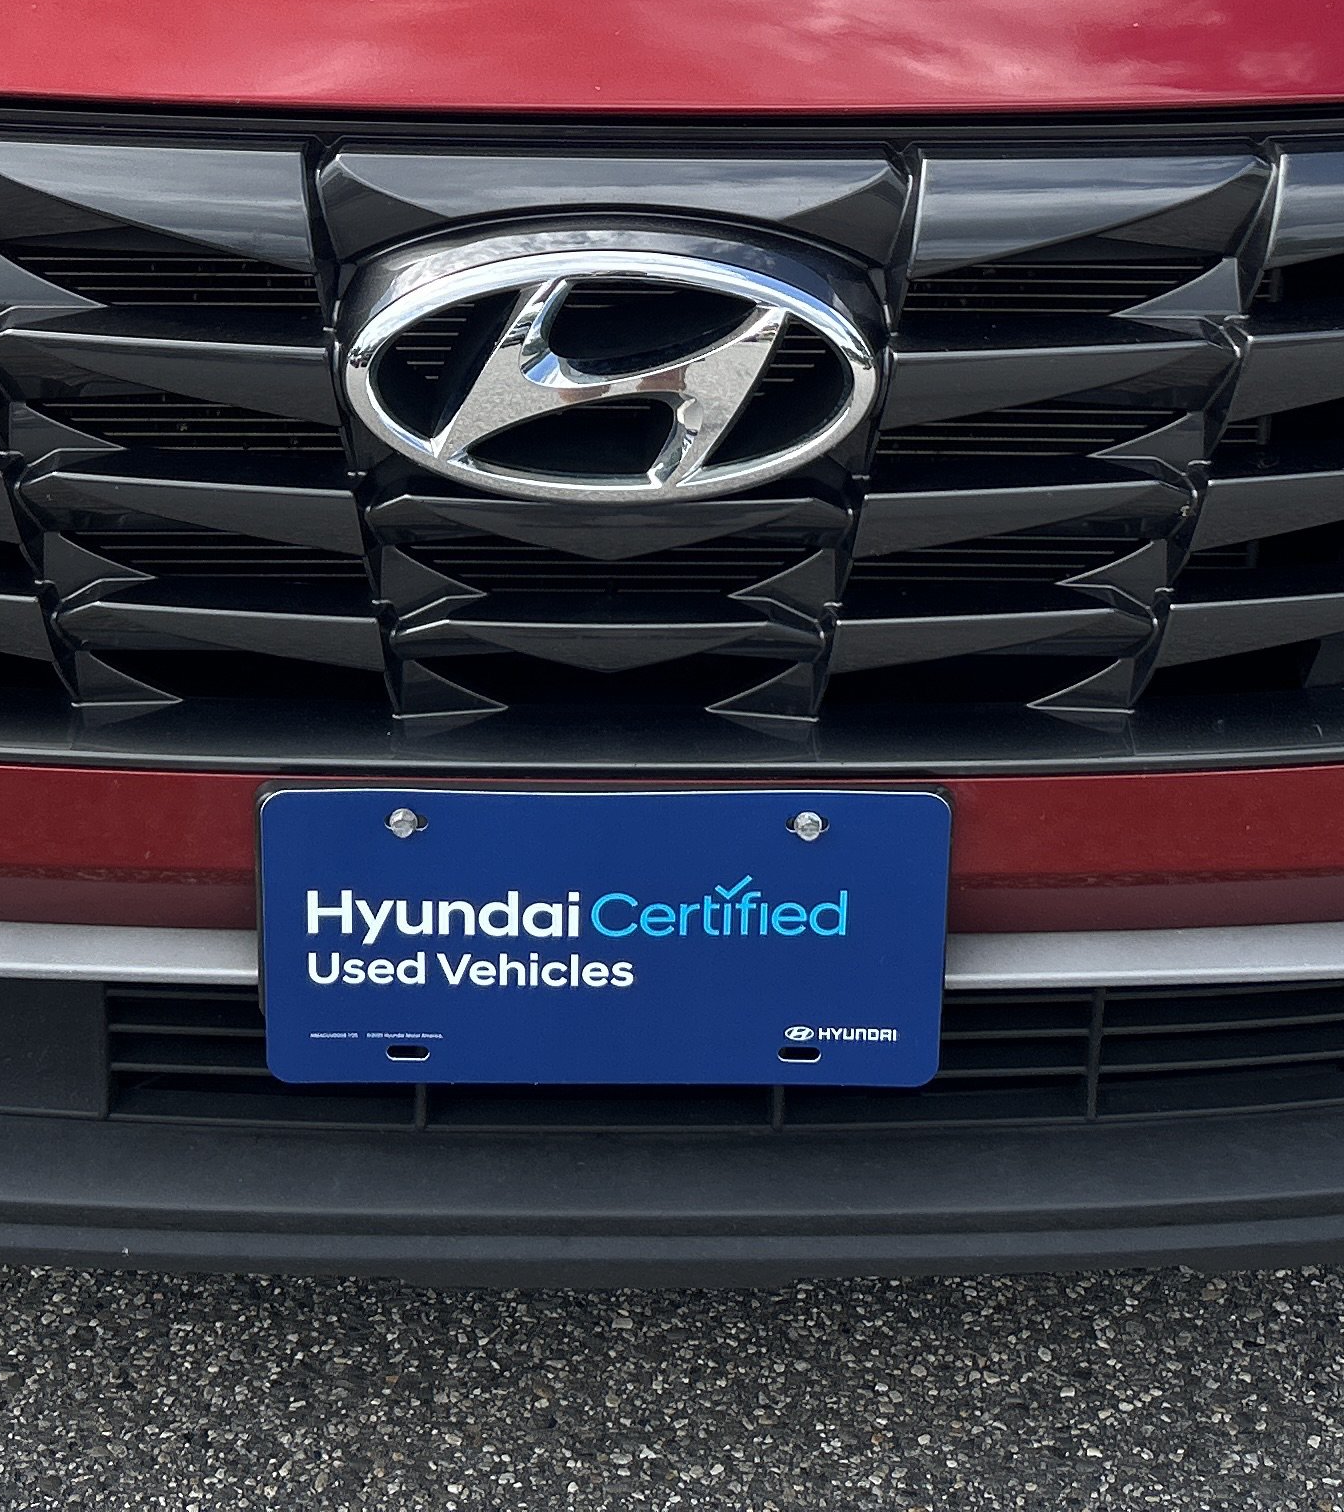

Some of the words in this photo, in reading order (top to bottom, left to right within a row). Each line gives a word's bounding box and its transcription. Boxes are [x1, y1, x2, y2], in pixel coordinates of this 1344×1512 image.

[307, 890, 580, 945] Hyundai
[590, 875, 848, 938] Certified
[308, 951, 426, 985] Used
[436, 952, 634, 987] Vehicles
[818, 1027, 897, 1042] HYUNDAI
